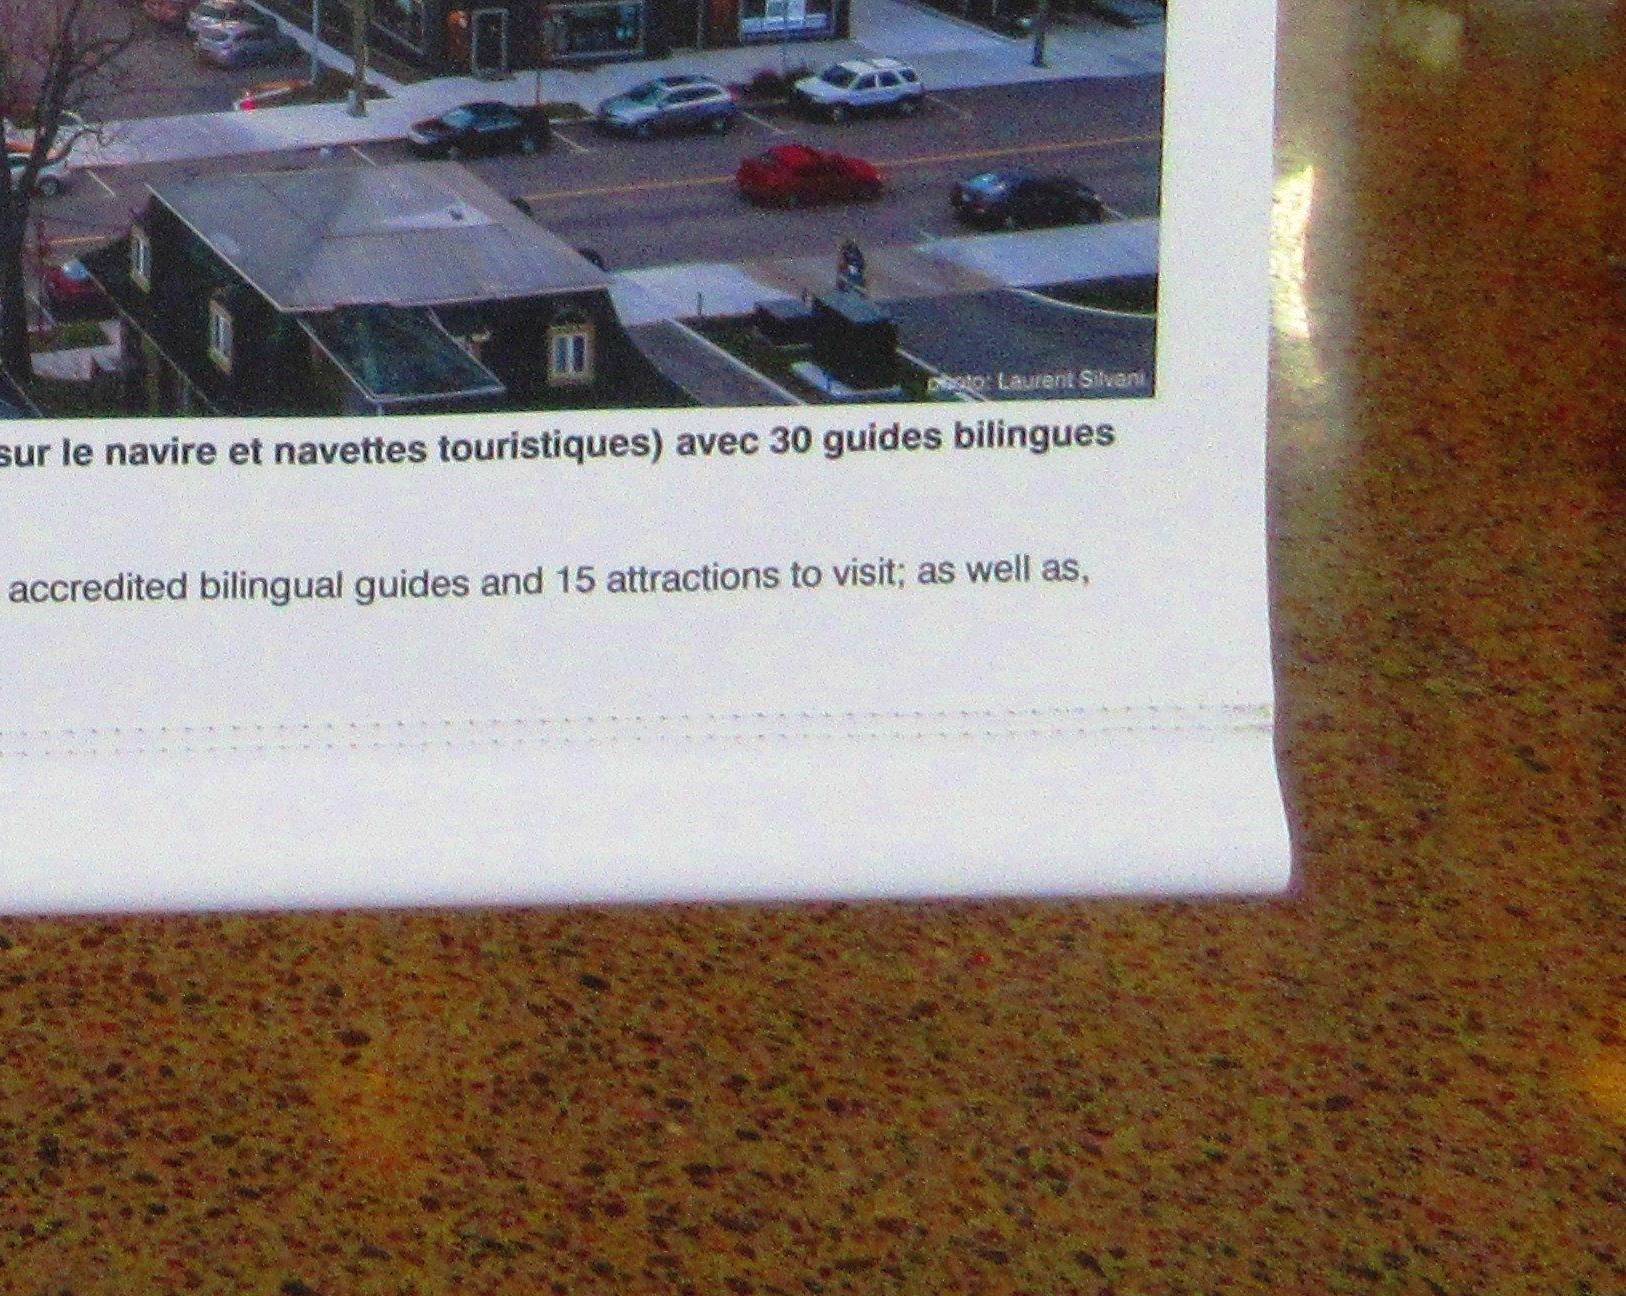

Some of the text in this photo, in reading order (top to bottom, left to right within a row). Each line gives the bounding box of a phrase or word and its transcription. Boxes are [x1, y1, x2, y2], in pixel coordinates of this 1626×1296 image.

[997, 370, 1075, 392] Laurent
[62, 437, 94, 468] le
[105, 435, 218, 467] navire
[228, 437, 263, 466] et
[274, 436, 428, 466] navettes
[437, 428, 664, 466] touristiques)
[676, 431, 759, 457] avec
[769, 424, 813, 455] 30
[822, 422, 943, 461] guides
[954, 418, 1116, 456] bilingues
[8, 571, 188, 604] accredited
[200, 570, 343, 608] bilingual
[354, 568, 470, 607] guides
[480, 565, 544, 597] and
[557, 565, 596, 594] 15
[606, 561, 781, 594] attractions
[790, 561, 823, 589] to
[832, 556, 905, 589] visit;
[917, 560, 956, 585] as
[965, 553, 1031, 584] well
[1041, 558, 1089, 584] as,
